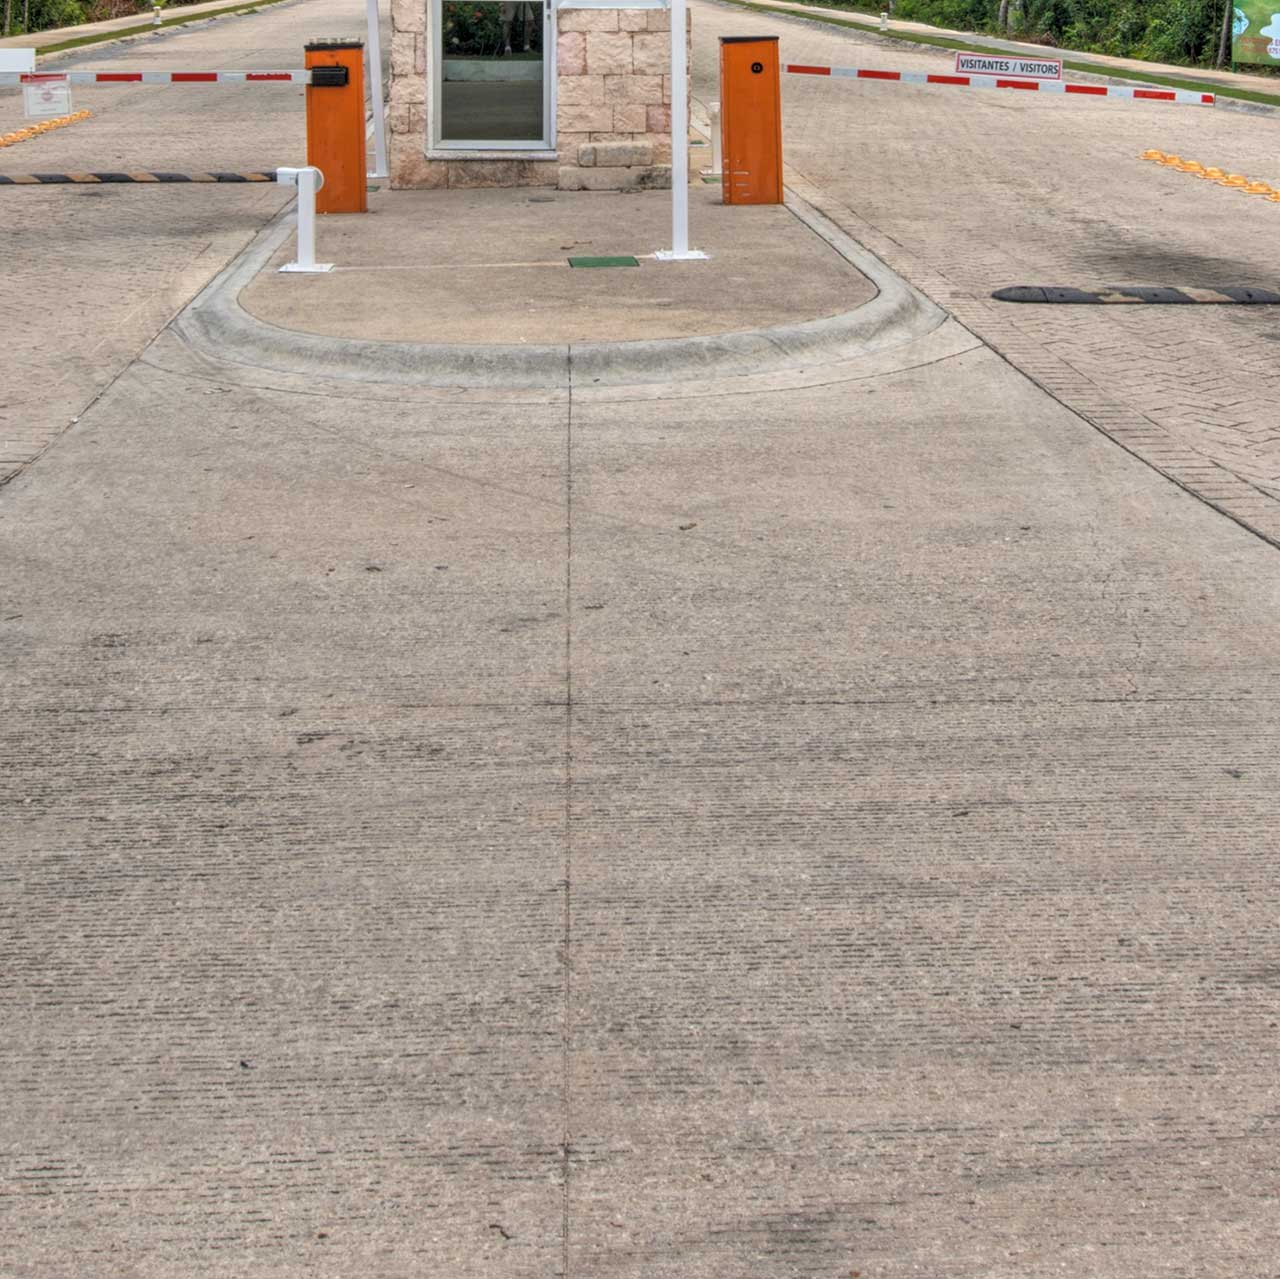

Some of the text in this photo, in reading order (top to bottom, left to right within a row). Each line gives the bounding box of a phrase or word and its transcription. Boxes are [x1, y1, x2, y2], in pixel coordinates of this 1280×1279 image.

[960, 59, 1058, 75] VISITANTES / VISITORS
